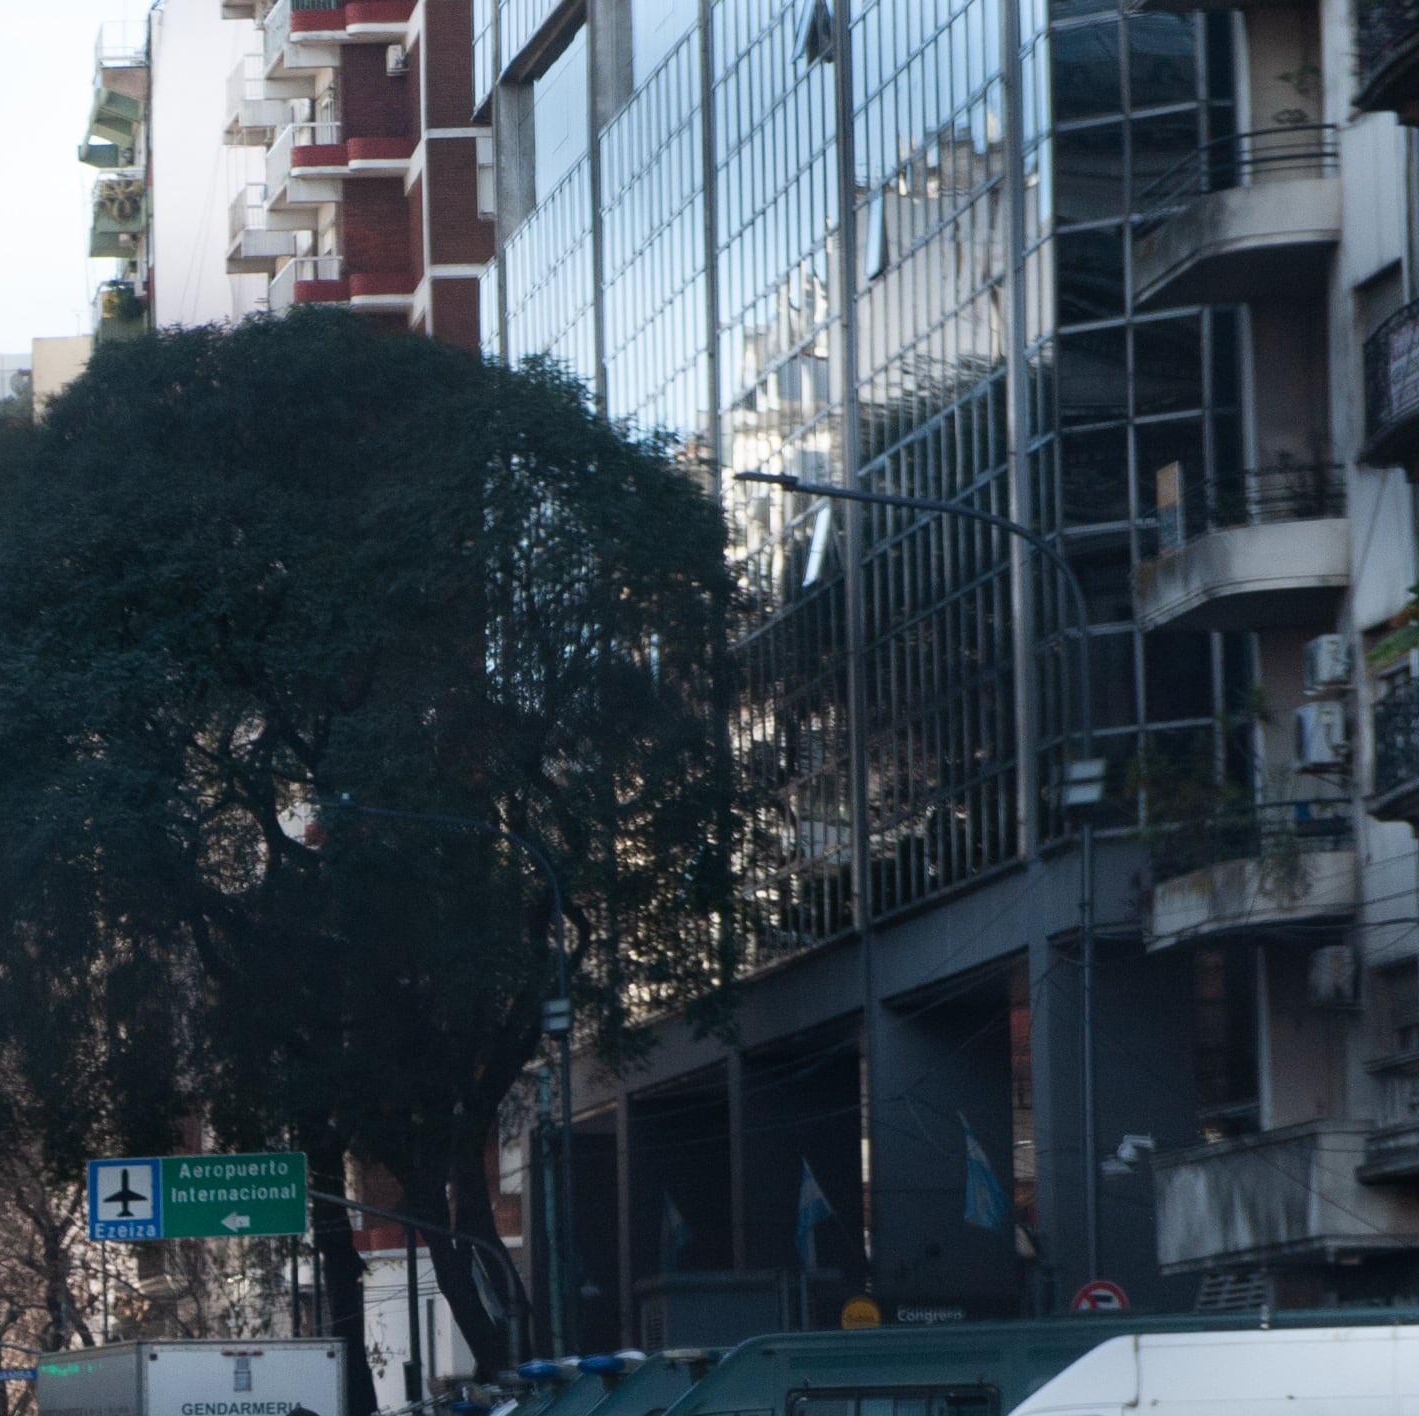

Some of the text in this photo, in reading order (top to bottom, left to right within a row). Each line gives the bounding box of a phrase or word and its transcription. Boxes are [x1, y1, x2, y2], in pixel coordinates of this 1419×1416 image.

[179, 1160, 289, 1180] Aeropuerto
[171, 1184, 296, 1203] Internacional
[94, 1223, 156, 1239] Ezeiza
